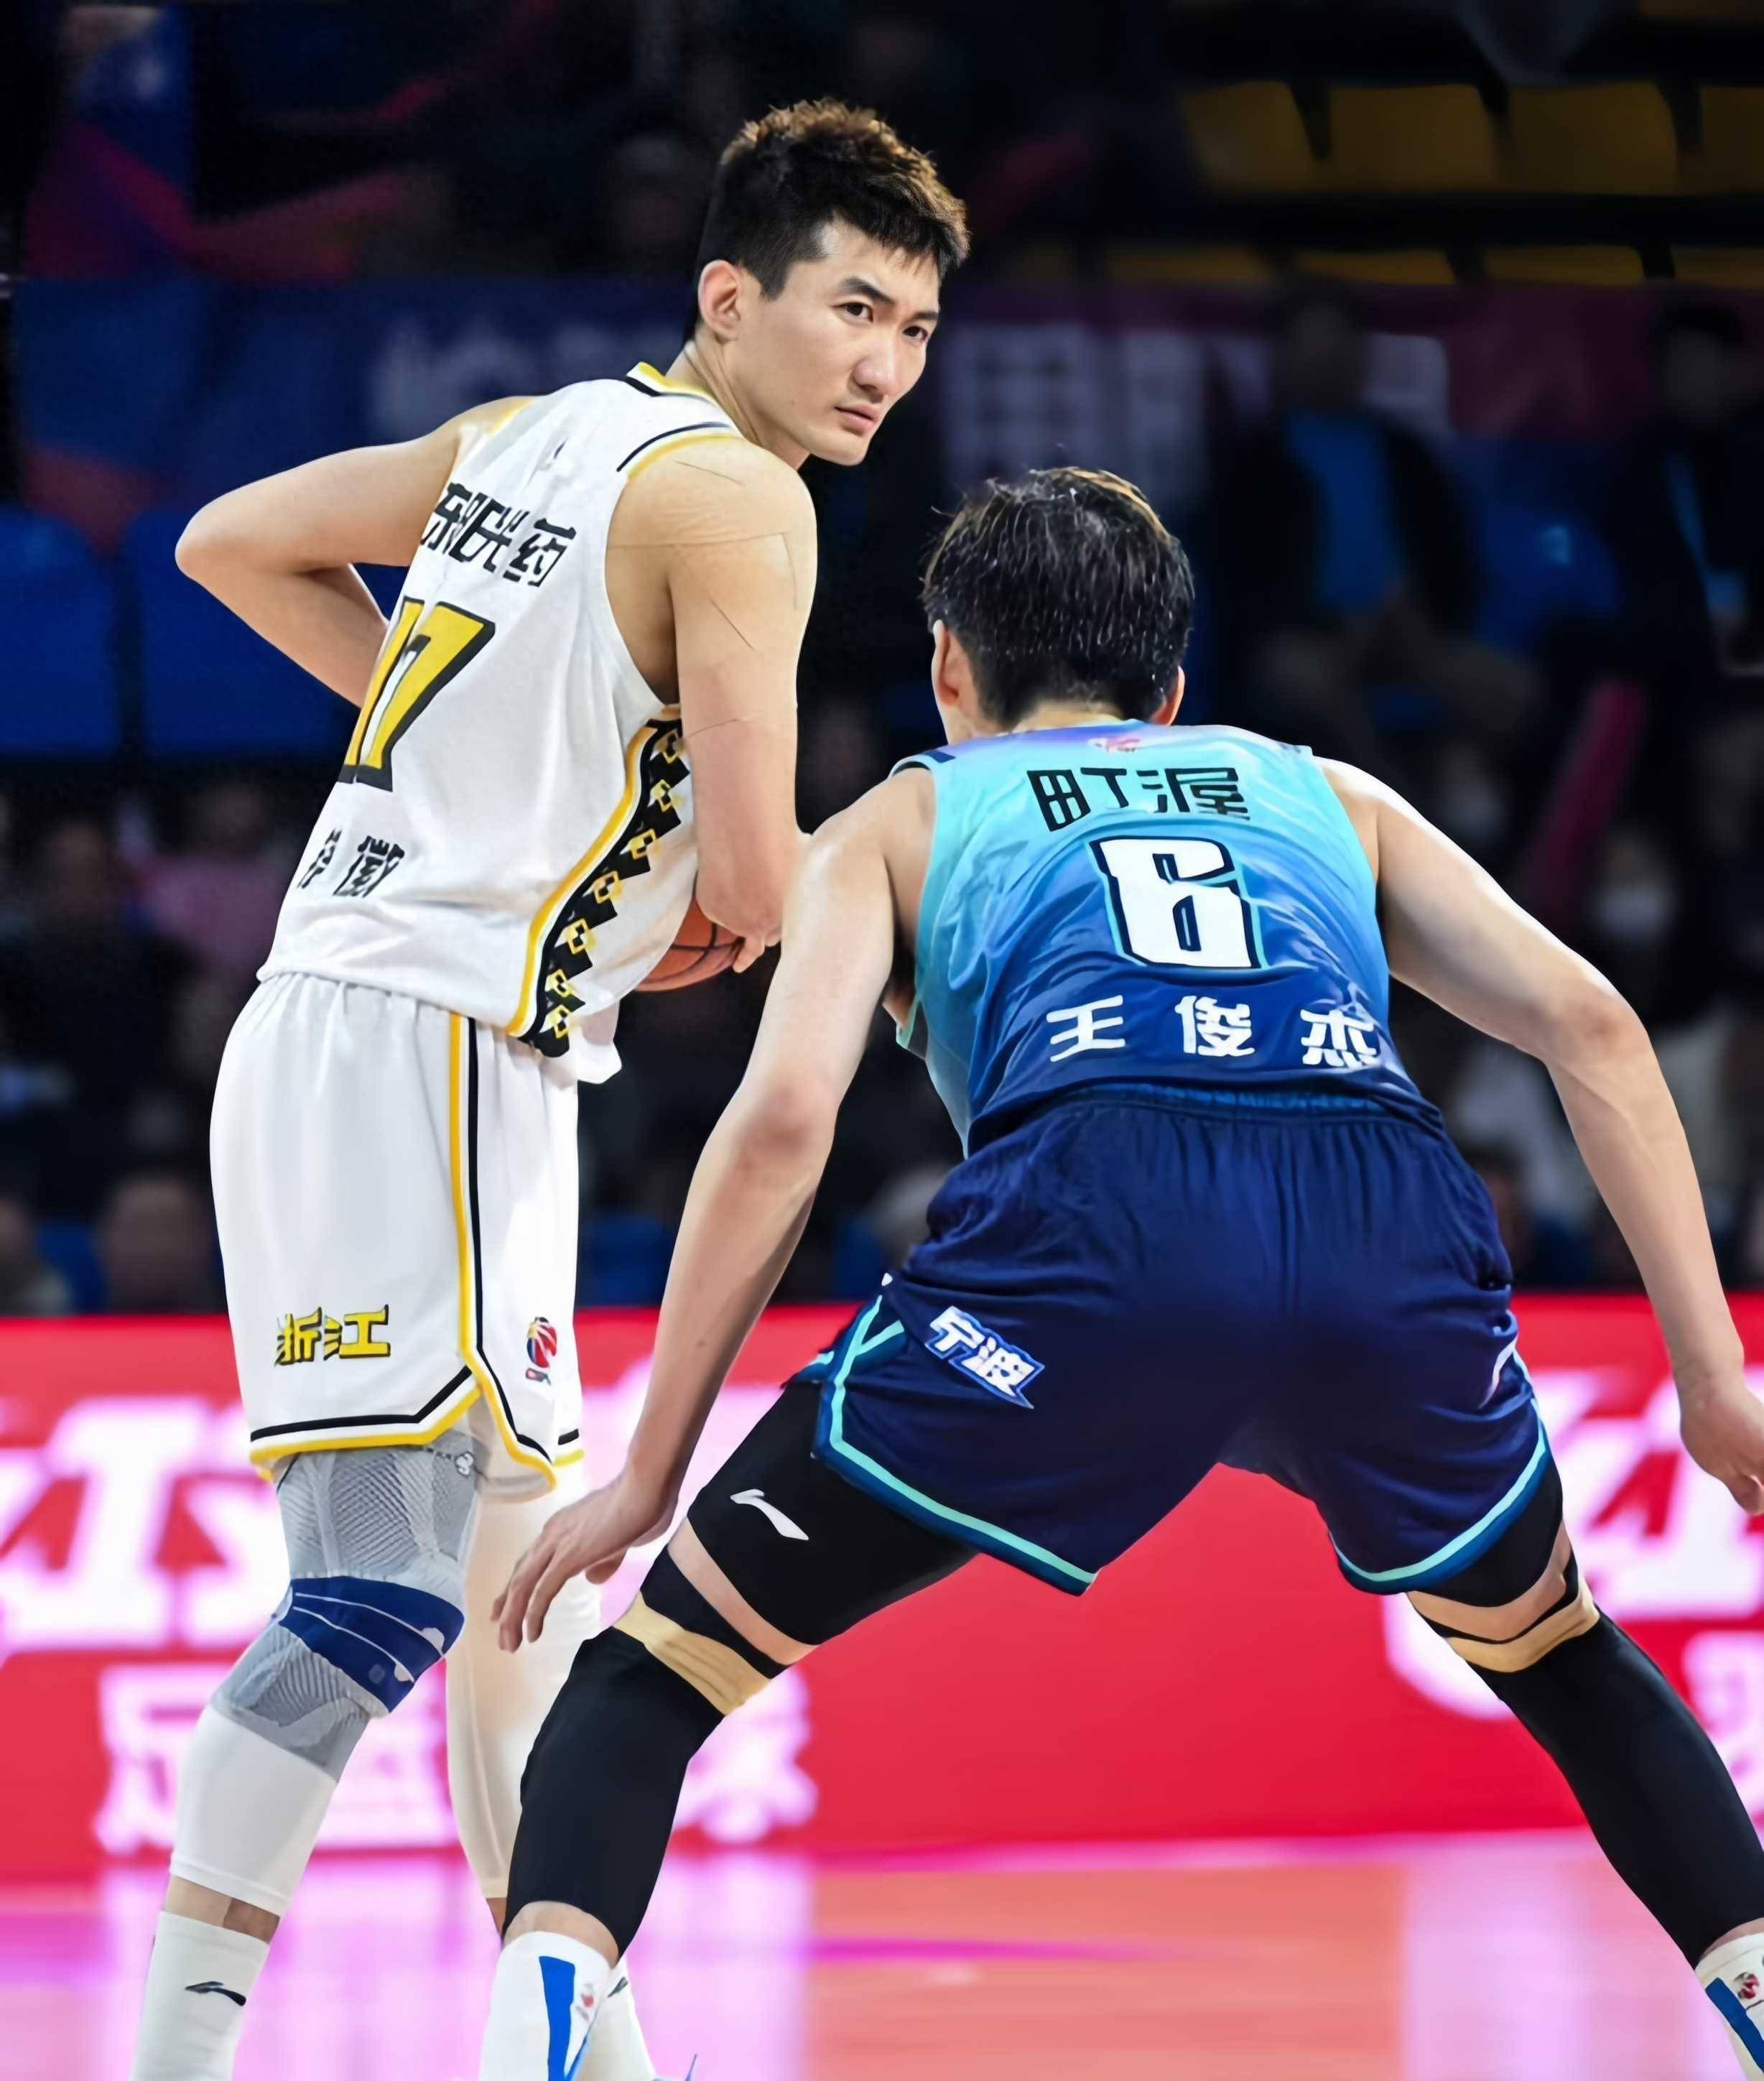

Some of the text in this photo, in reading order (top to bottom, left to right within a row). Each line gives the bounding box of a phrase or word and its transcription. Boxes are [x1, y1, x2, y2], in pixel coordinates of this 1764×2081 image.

[1026, 766, 1250, 832] 町渥
[1090, 835, 1266, 970] 6
[1046, 995, 1378, 1069] 王俊杰
[275, 1304, 391, 1366] 浙江
[928, 1304, 1039, 1404] 宁波
